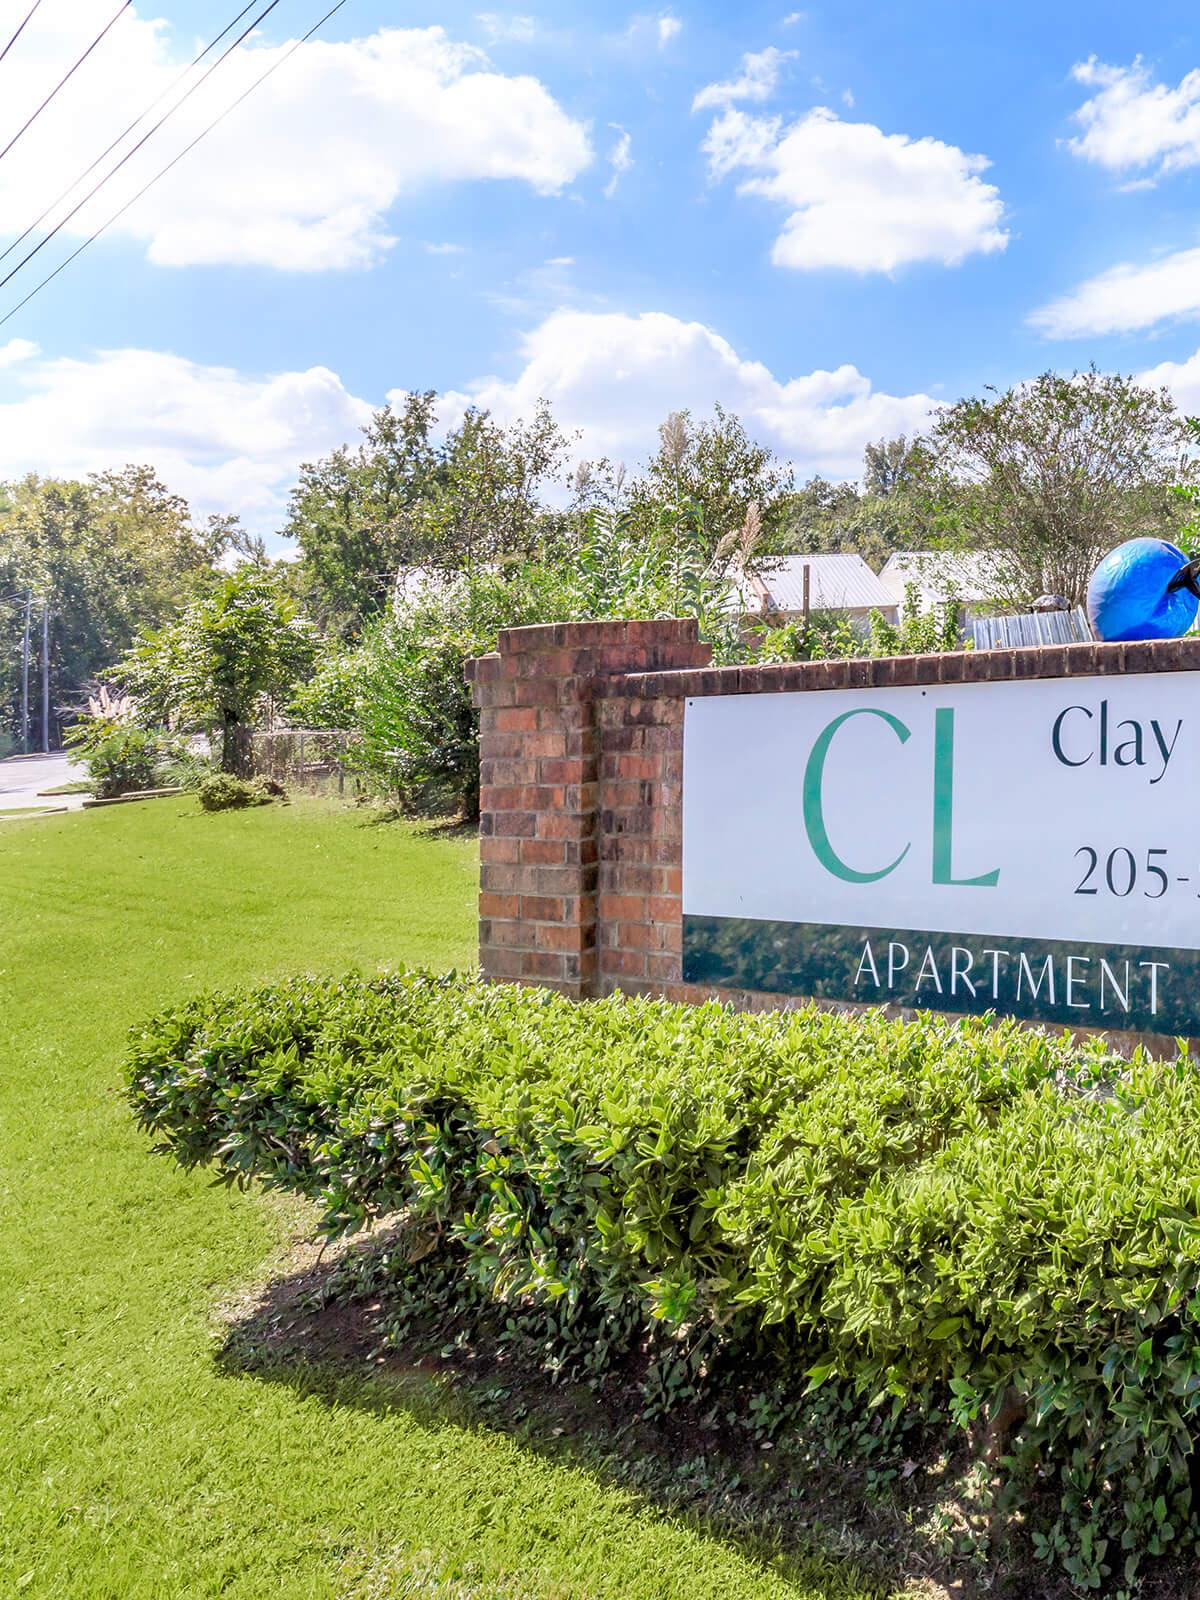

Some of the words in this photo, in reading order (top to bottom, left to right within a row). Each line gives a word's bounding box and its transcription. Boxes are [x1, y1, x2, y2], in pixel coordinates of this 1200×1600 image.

[1051, 699, 1183, 785] Clay
[802, 706, 1001, 888] CL
[853, 940, 1170, 1015] APARTMENT
